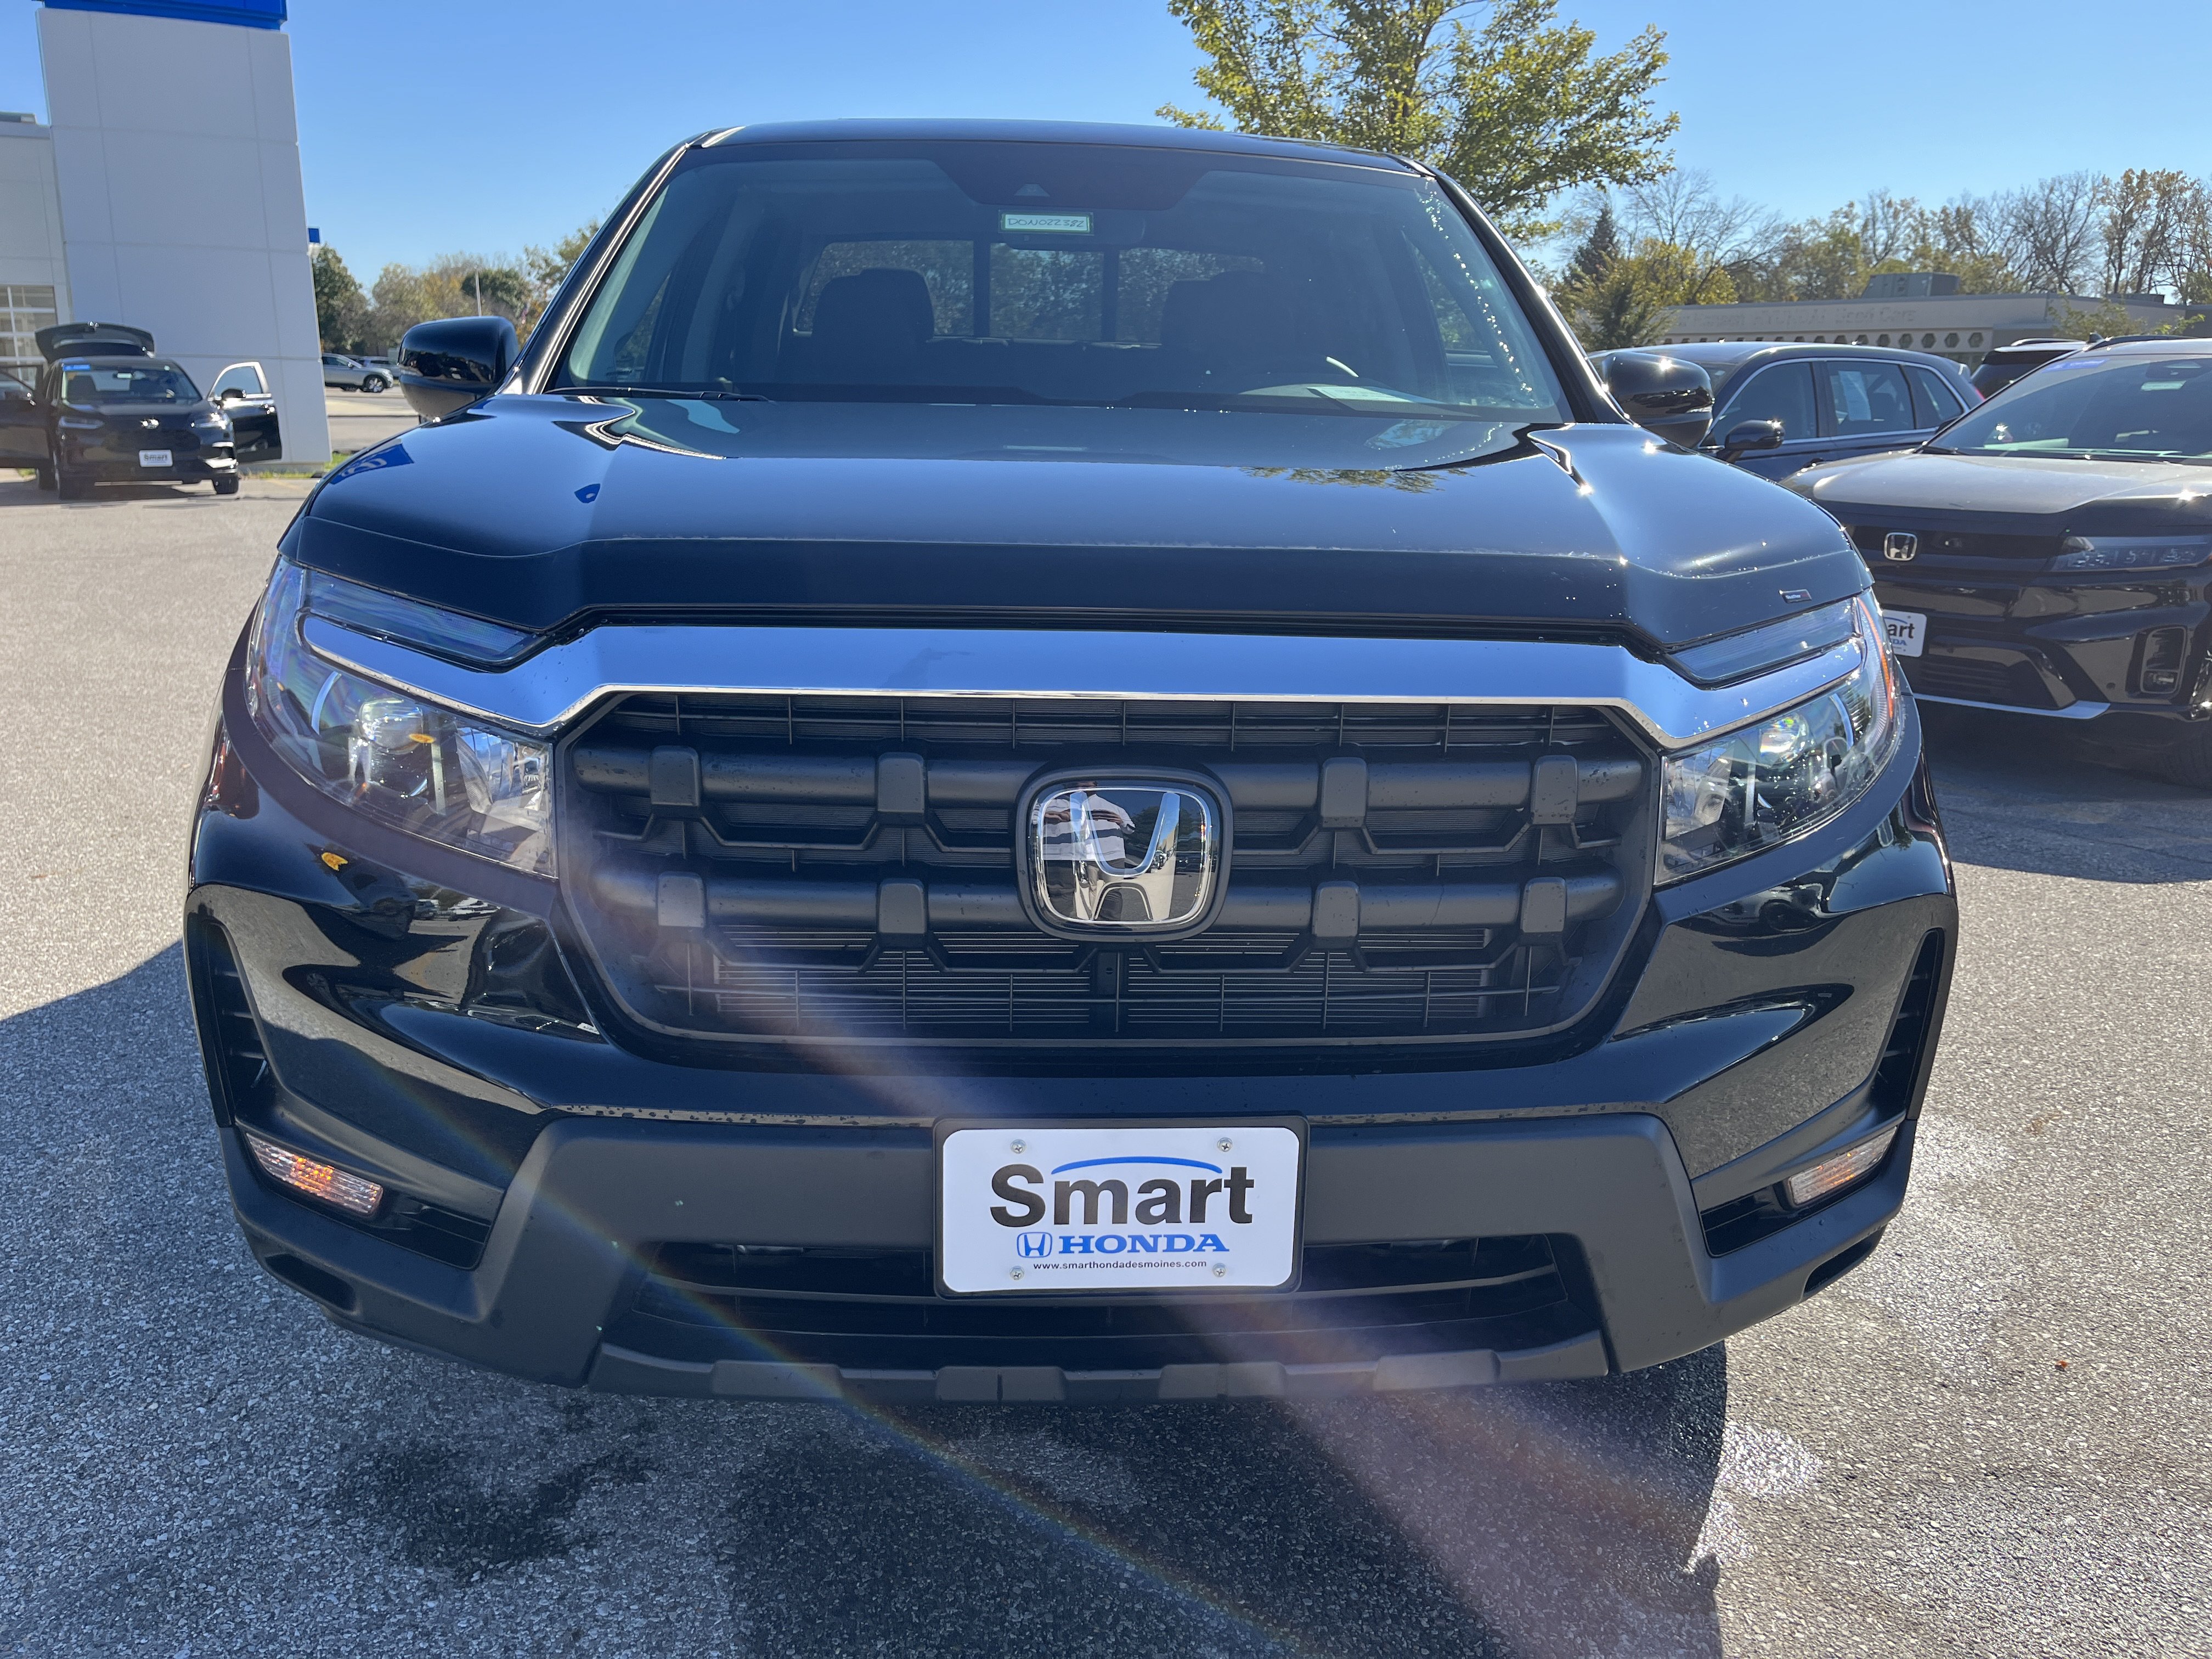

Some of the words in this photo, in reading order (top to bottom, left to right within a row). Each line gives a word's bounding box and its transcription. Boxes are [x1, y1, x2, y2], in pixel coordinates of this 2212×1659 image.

[1887, 623, 1915, 639] art
[989, 1163, 1255, 1227] Smart
[1058, 1233, 1230, 1254] HONDA
[1032, 1260, 1207, 1269] www.smarthondadesmoines.com
